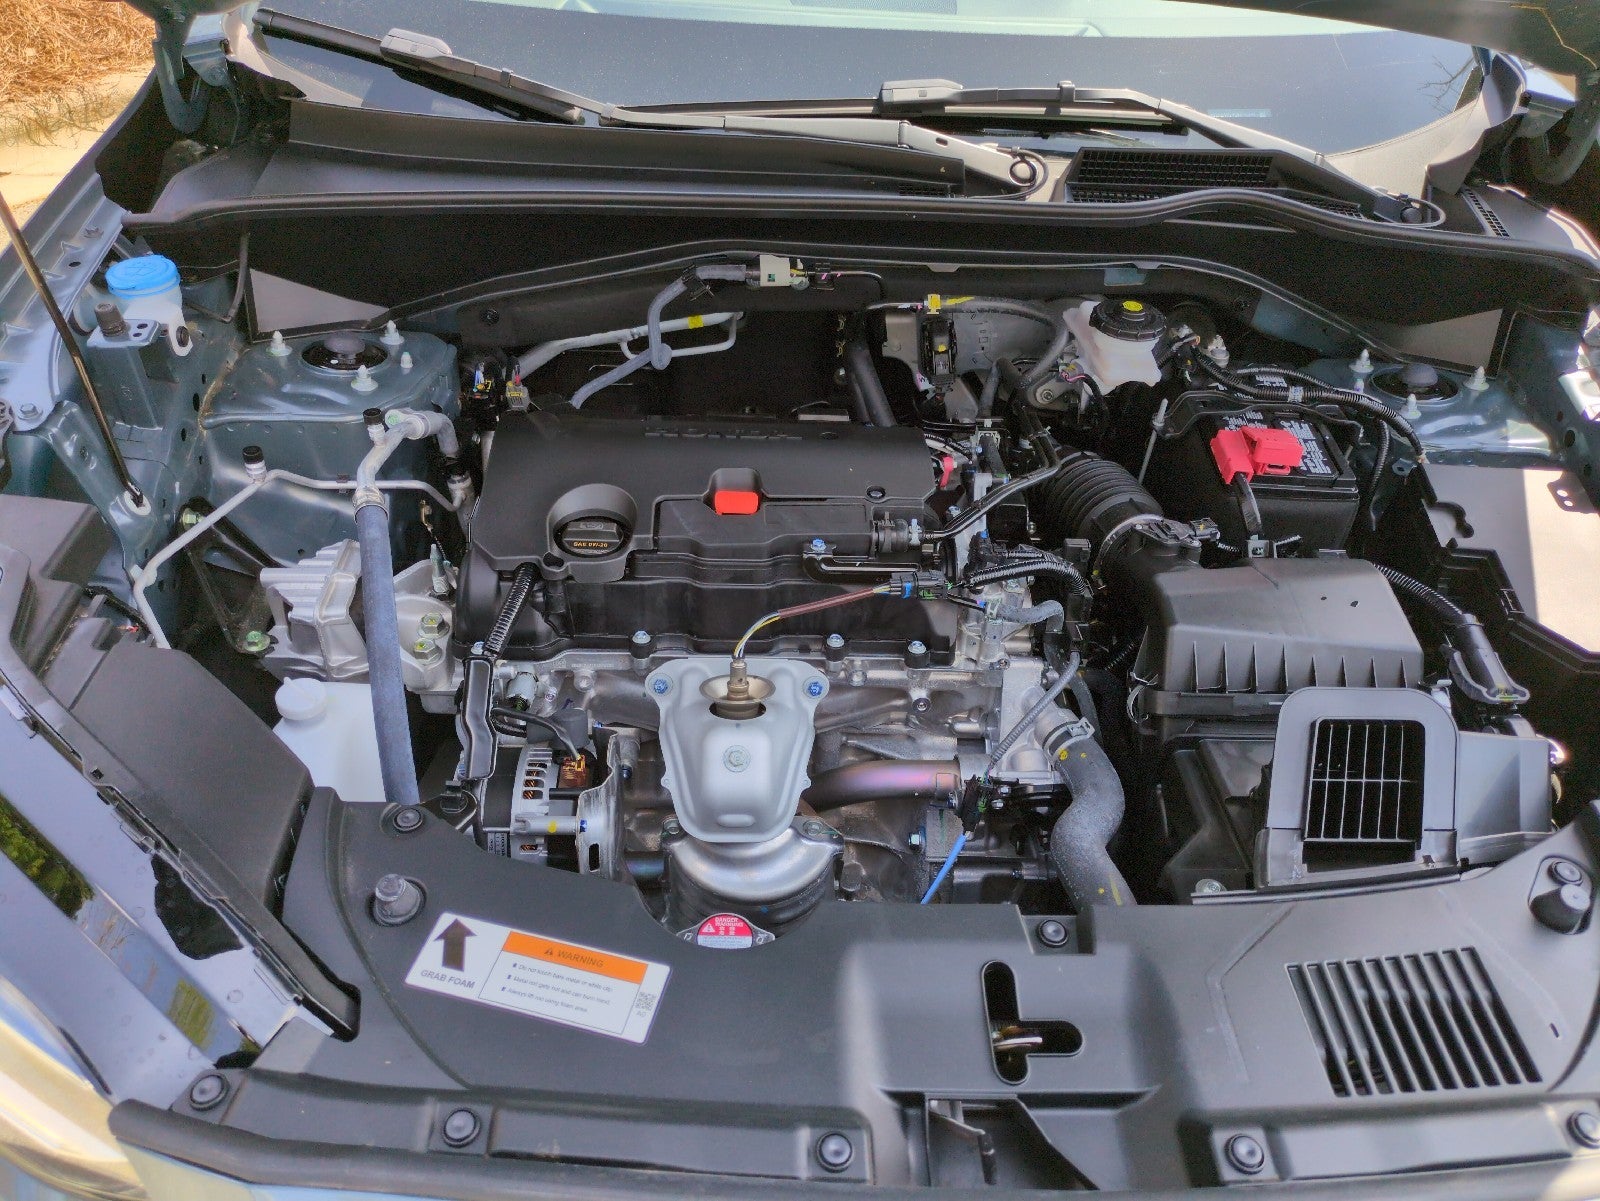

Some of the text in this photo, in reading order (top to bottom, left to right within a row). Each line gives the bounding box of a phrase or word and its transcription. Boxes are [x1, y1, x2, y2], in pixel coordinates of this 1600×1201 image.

[557, 949, 604, 968] WARNING
[421, 970, 476, 989] GRAB FOAM
